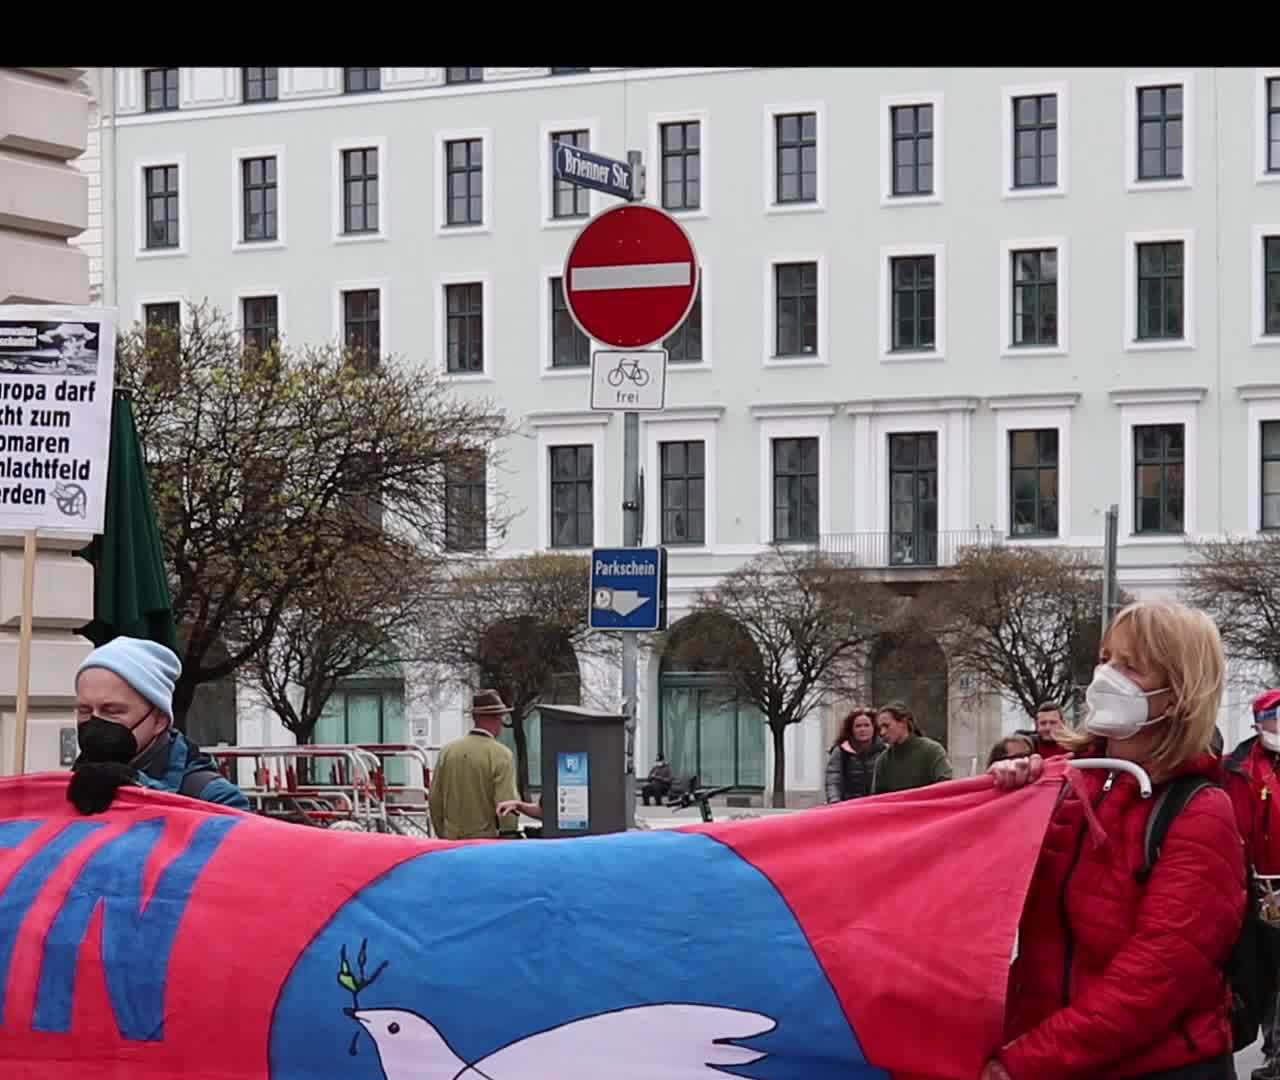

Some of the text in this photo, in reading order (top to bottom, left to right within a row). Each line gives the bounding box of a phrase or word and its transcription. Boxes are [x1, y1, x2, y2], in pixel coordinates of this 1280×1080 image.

[564, 148, 610, 184] Brienner
[55, 380, 96, 402] darf
[616, 390, 639, 403] frei
[30, 410, 70, 428] zum
[595, 559, 656, 576] Parkschein
